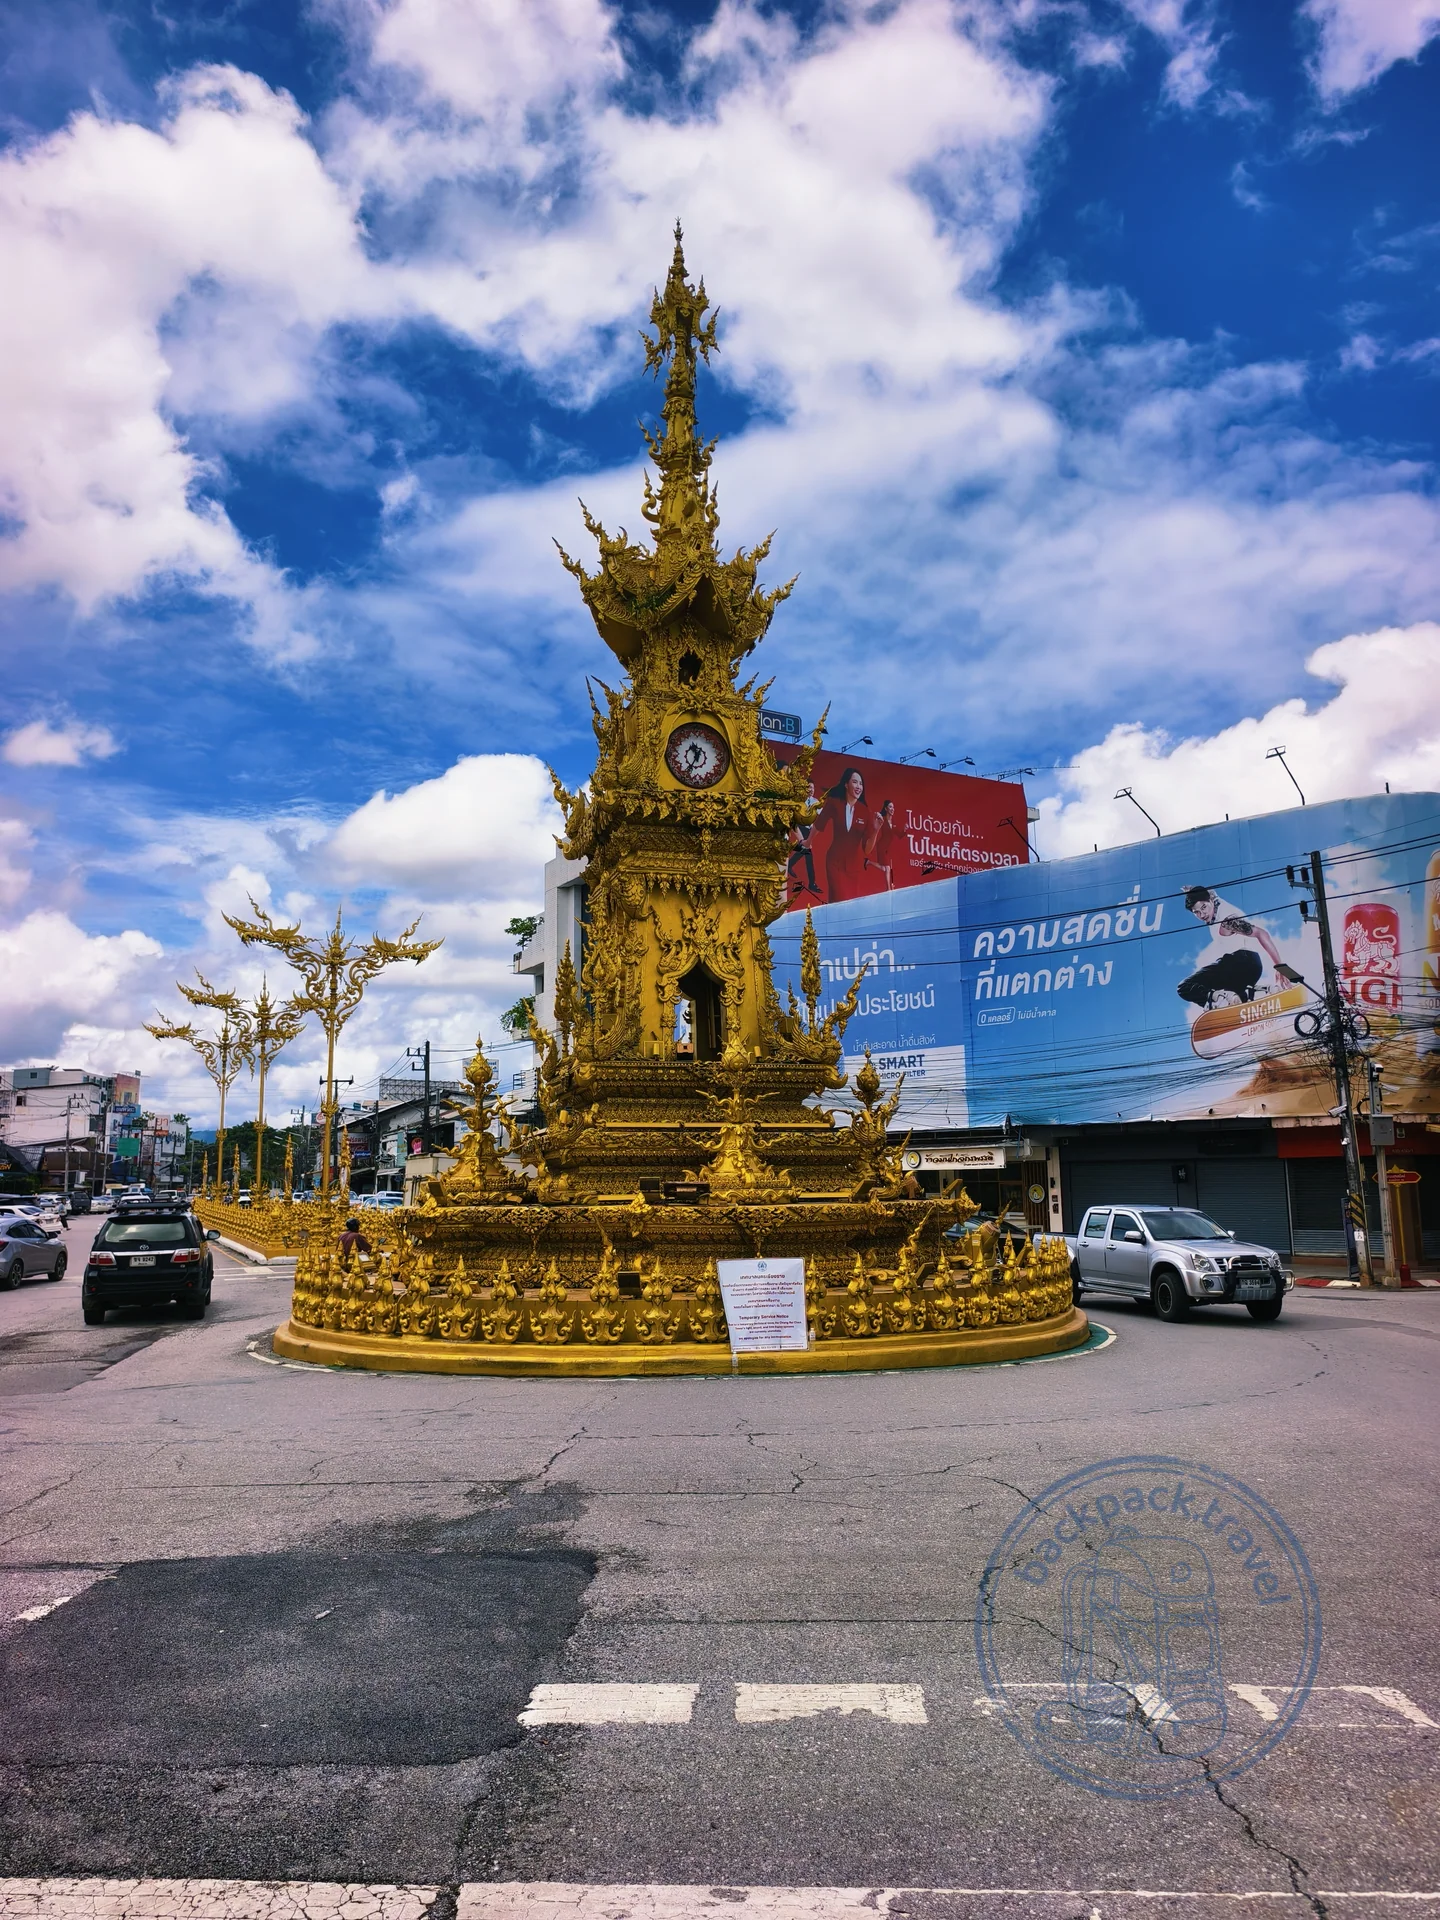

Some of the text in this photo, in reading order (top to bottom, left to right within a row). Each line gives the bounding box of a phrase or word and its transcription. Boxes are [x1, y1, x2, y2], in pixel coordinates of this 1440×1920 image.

[906, 809, 984, 839] ไปด้วยกัน...
[907, 834, 1019, 867] ไปไหนก็ตรงเวลา
[973, 884, 1164, 958] ความสดชื่น
[975, 955, 1113, 1000] ที่แตกต่าง
[980, 1013, 987, 1024] 0
[1240, 997, 1282, 1024] SINGHA
[879, 1054, 925, 1070] SMART
